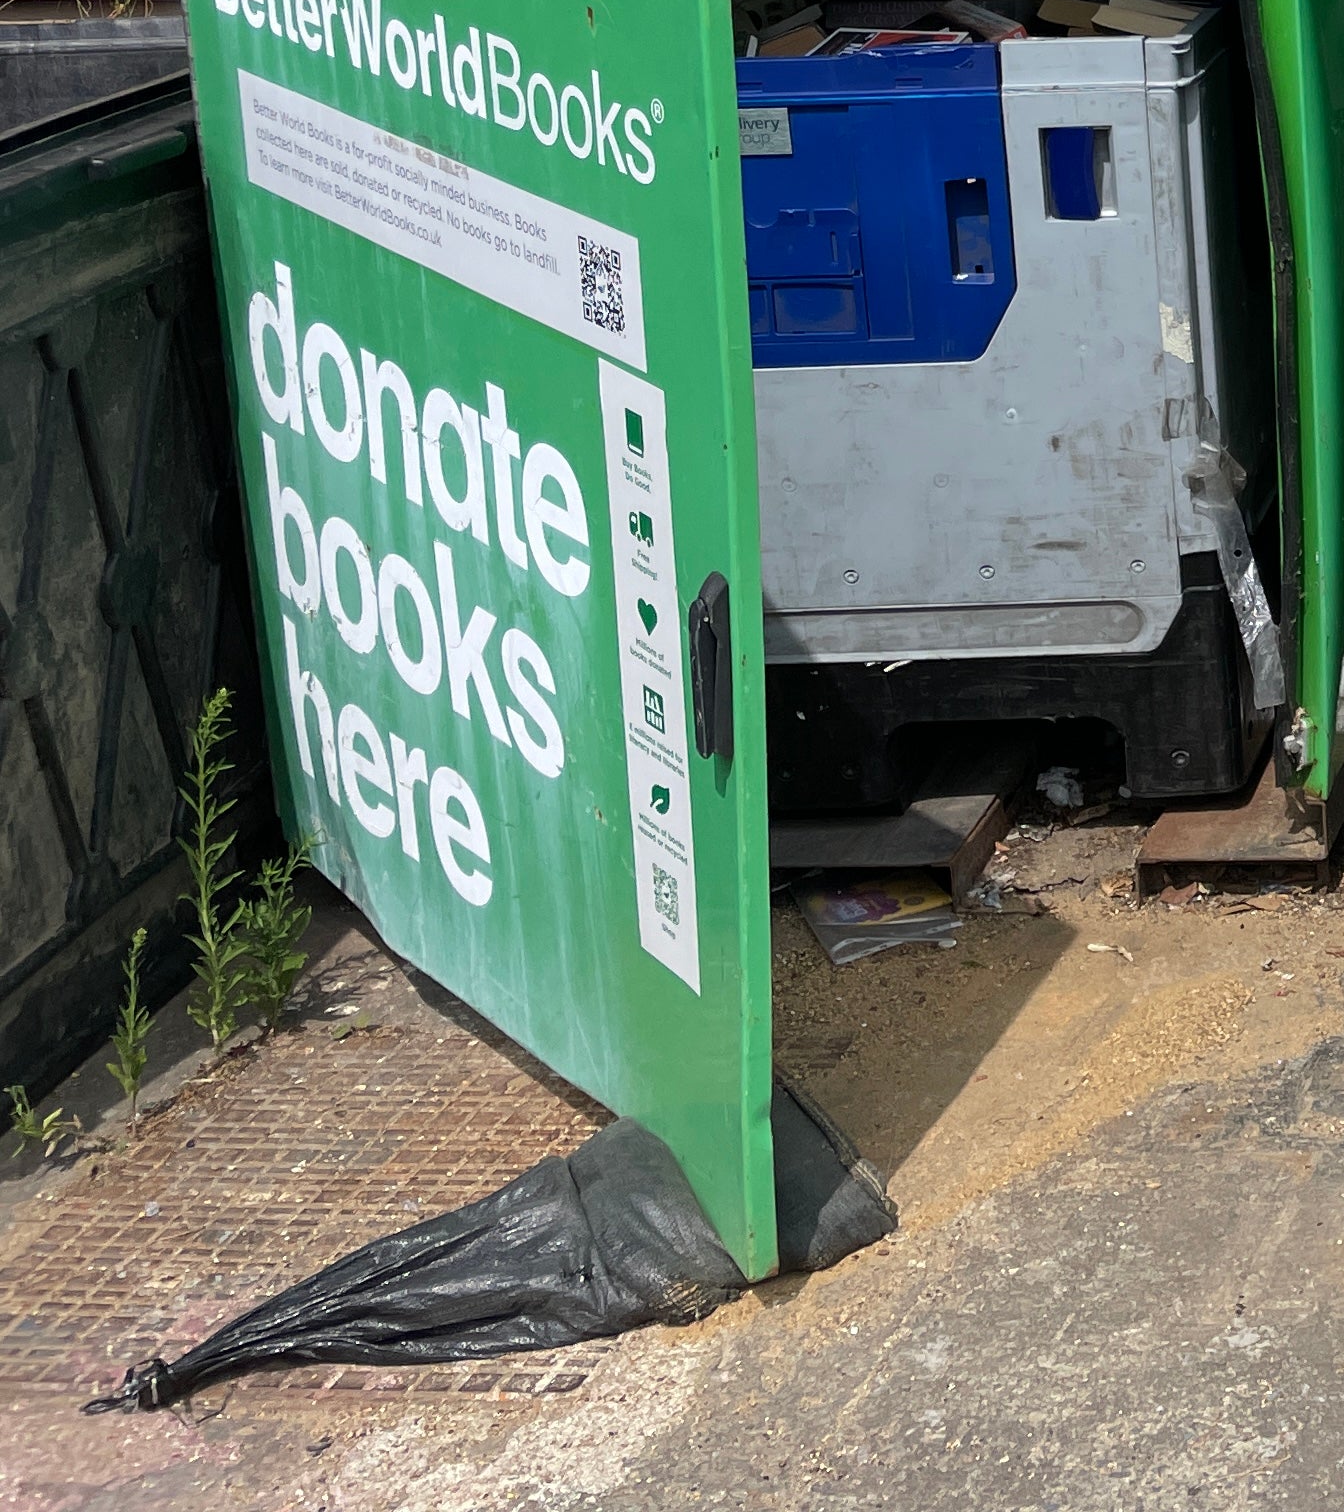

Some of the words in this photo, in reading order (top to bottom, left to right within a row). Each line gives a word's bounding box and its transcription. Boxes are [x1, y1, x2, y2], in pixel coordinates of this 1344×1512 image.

[258, 149, 269, 162] To
[270, 156, 290, 173] learn
[292, 168, 314, 188] more
[316, 177, 333, 196] visit
[249, 260, 591, 599] donate
[261, 430, 565, 779] books
[283, 614, 494, 907] here
